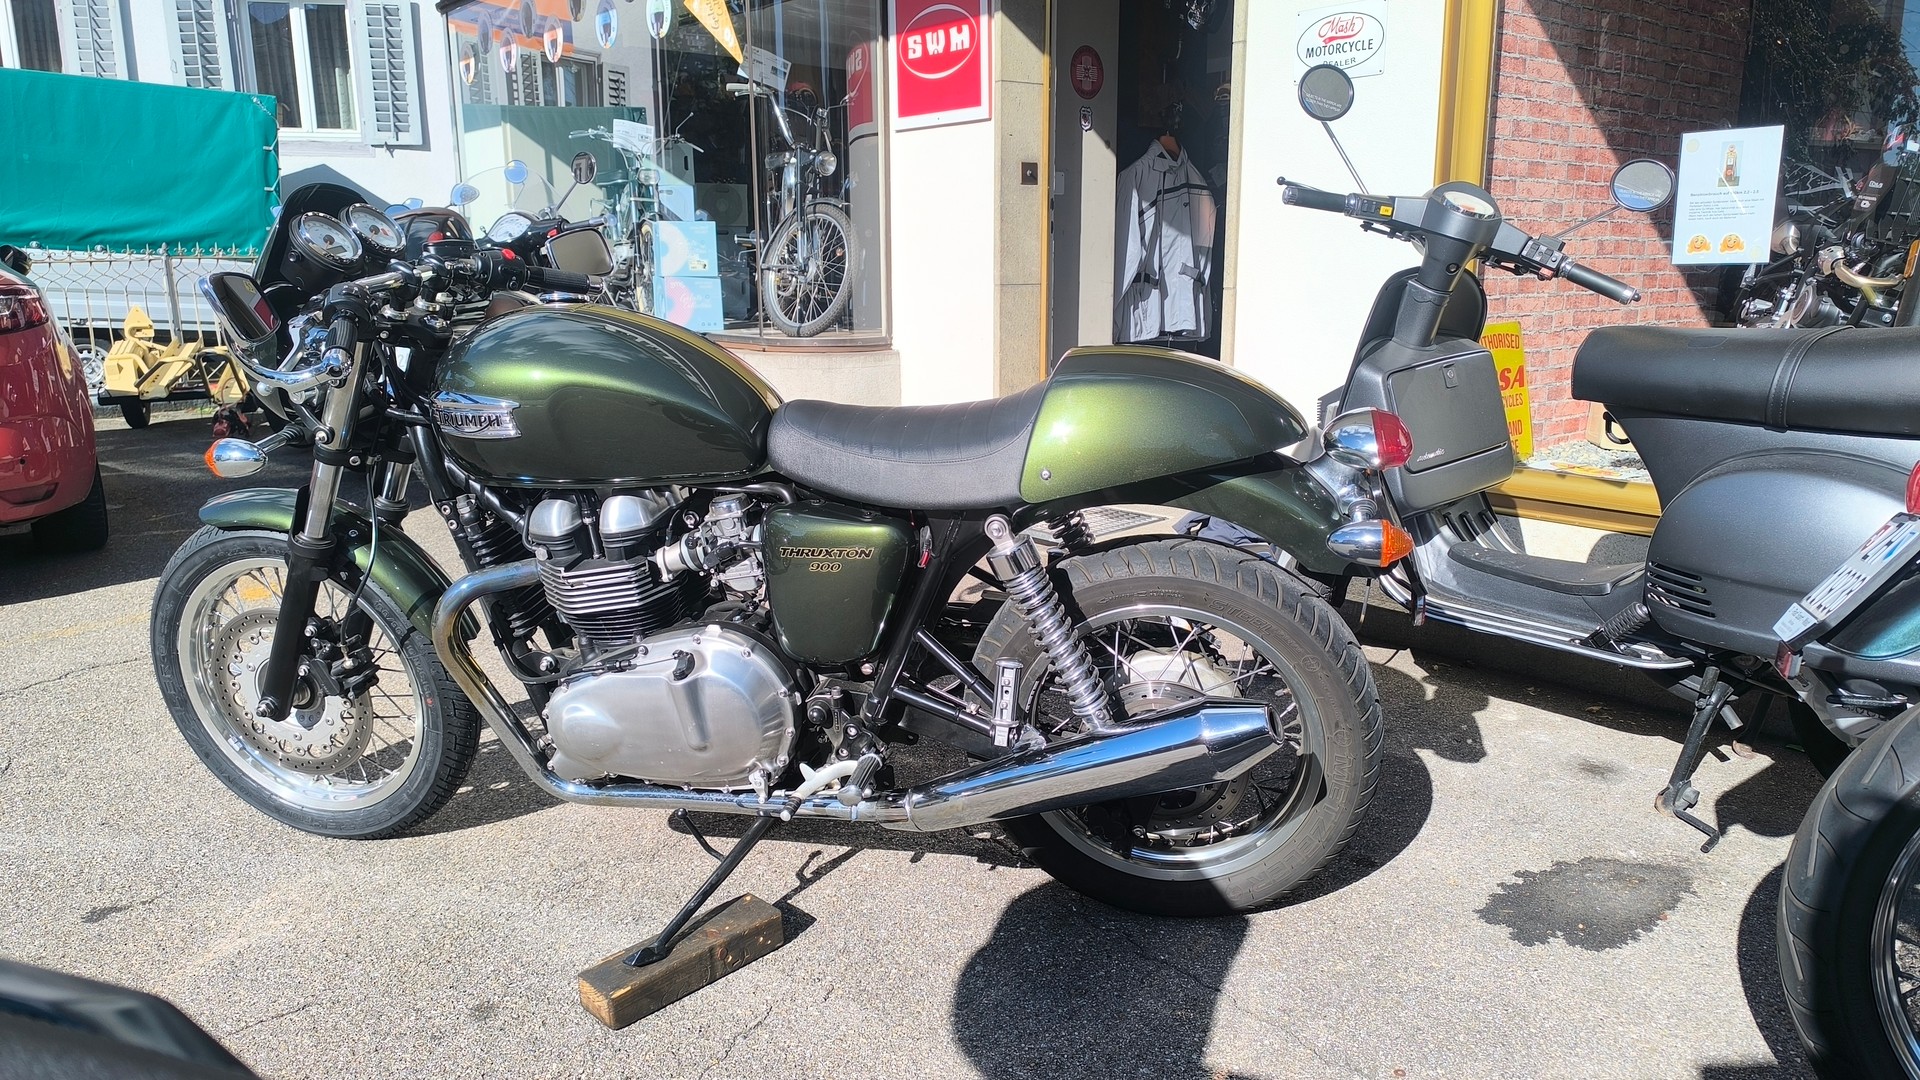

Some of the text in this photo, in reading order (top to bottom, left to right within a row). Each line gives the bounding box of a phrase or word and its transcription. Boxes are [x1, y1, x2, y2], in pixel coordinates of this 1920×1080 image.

[1318, 15, 1364, 39] Mash
[907, 24, 971, 60] SWM
[1305, 38, 1374, 59] MOTORCYCLE
[1502, 393, 1524, 408] YCLES
[437, 410, 502, 428] TRIUMPH
[780, 546, 874, 559] THRUXTON
[809, 562, 842, 572] 900
